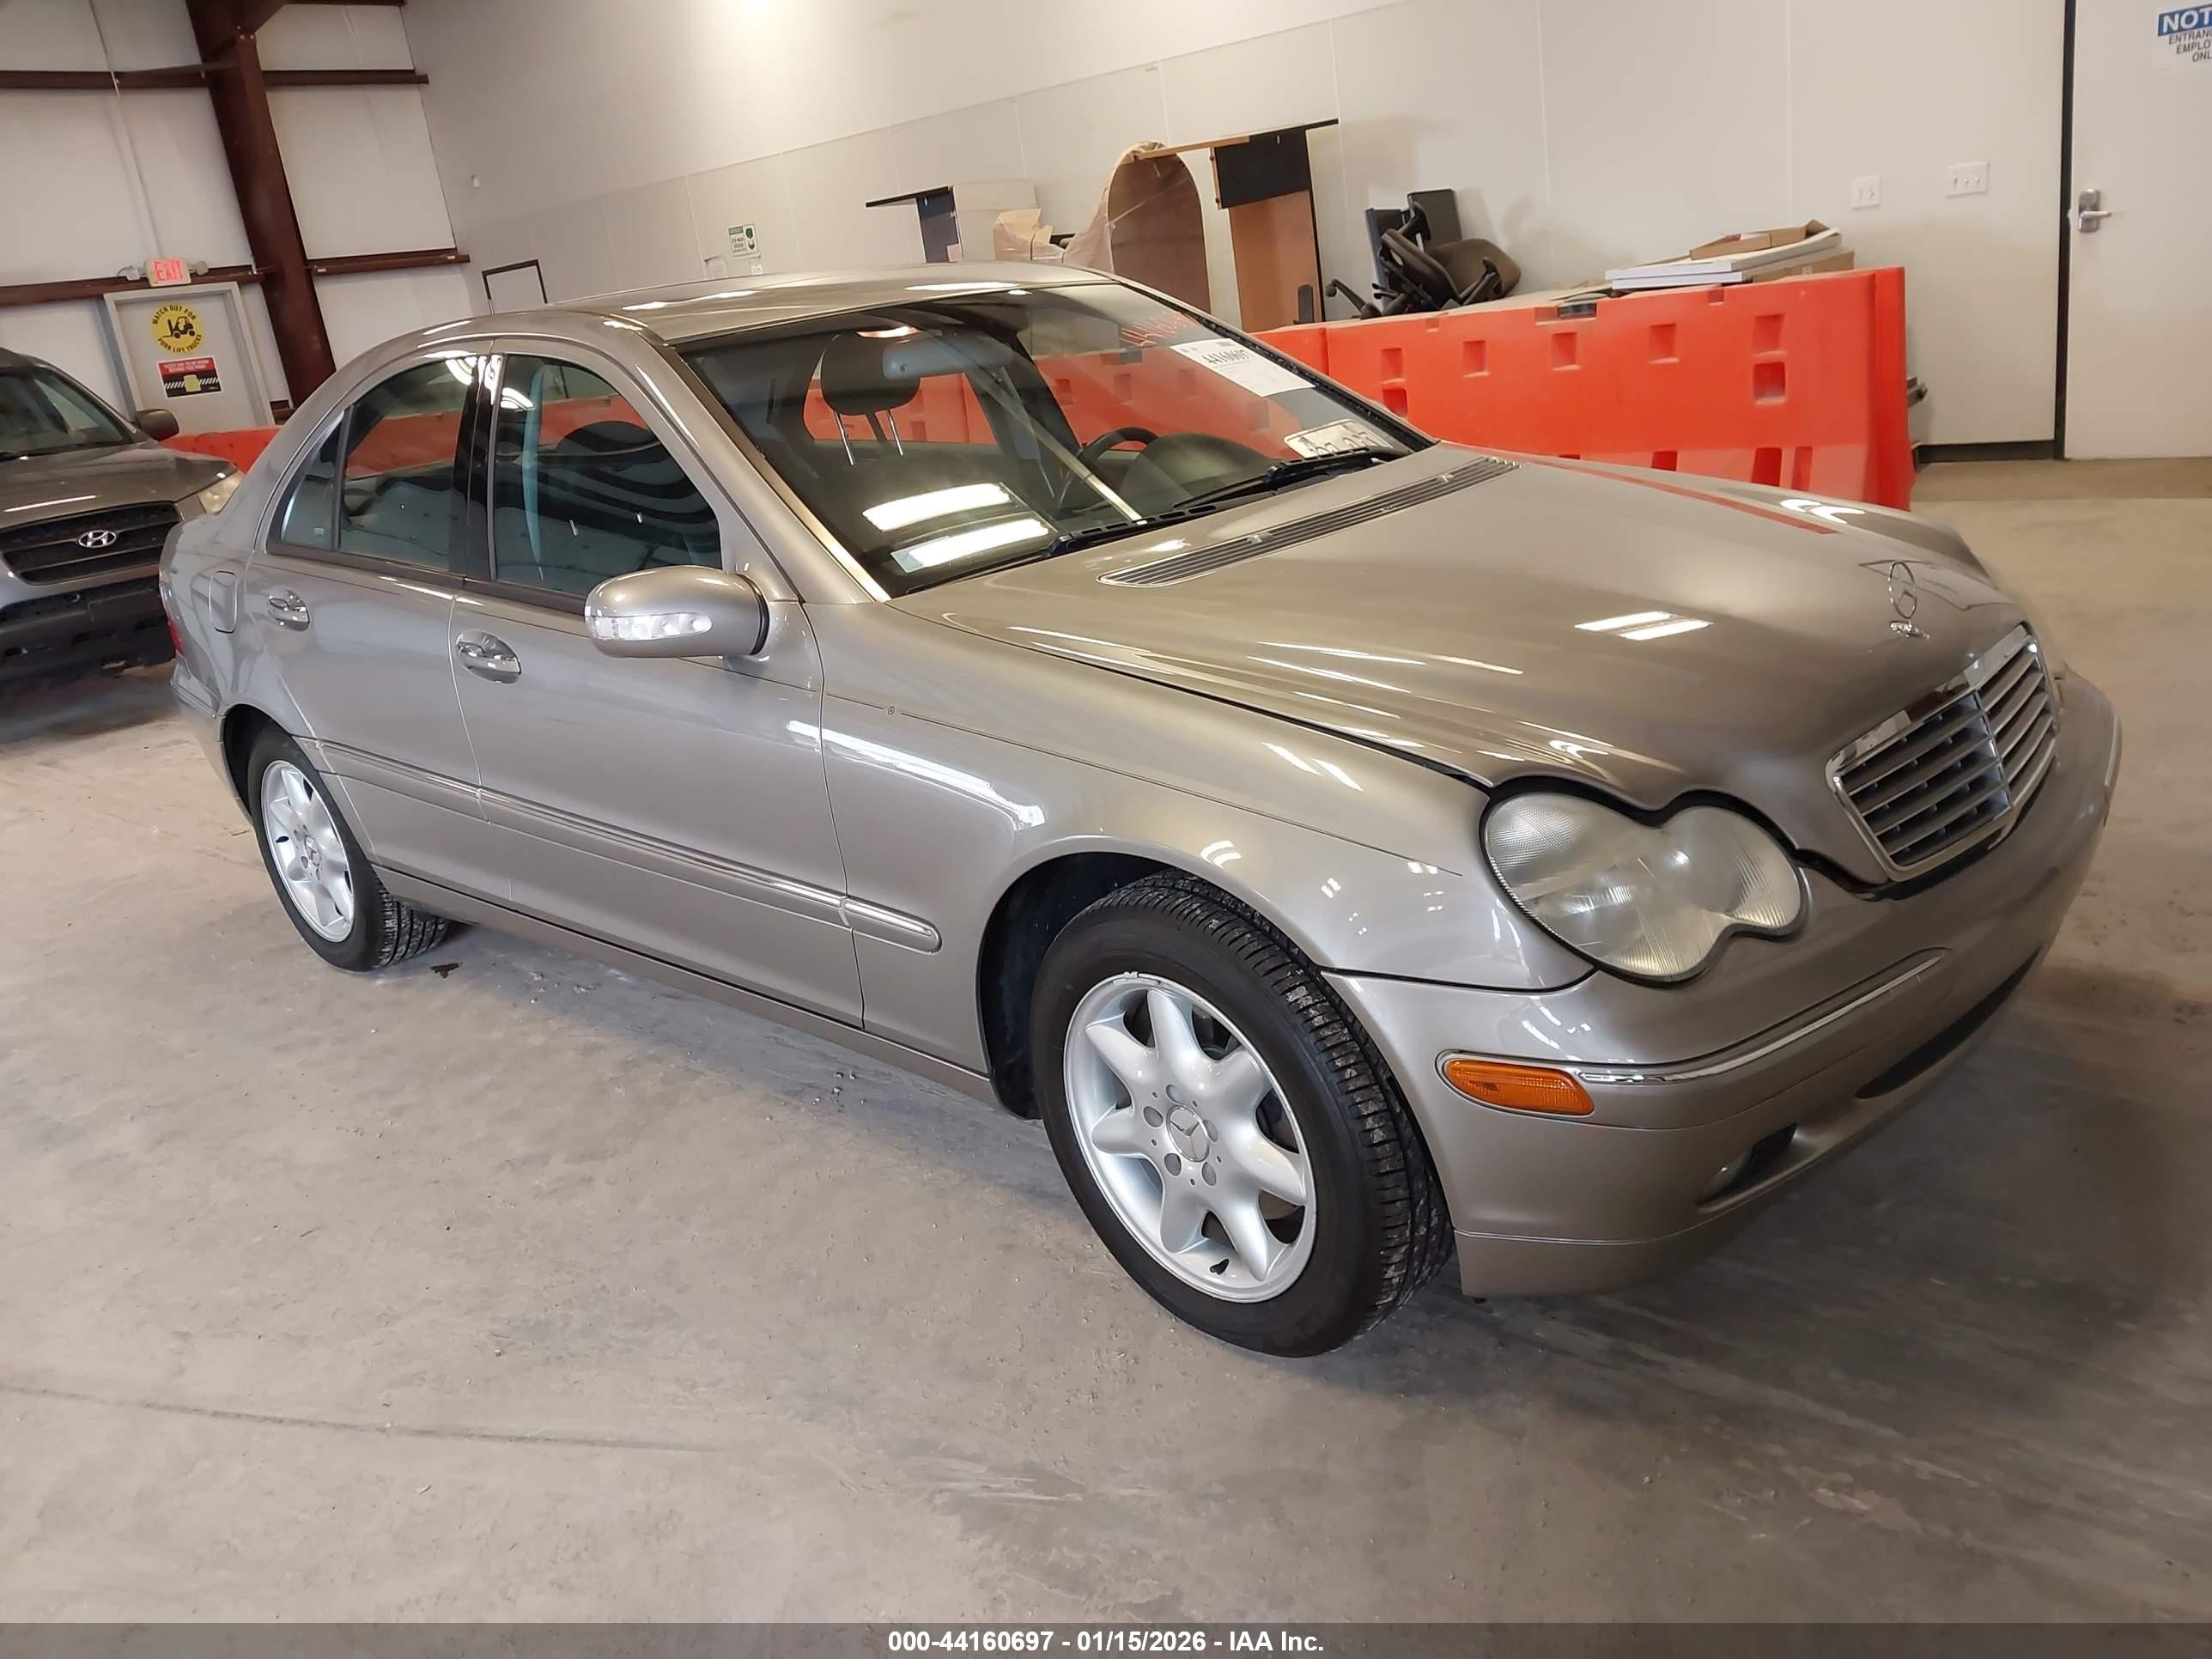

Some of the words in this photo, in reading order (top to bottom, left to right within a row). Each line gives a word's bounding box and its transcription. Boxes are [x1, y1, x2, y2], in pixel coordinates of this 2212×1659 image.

[152, 307, 168, 324] WATCH
[184, 308, 197, 320] FOR
[157, 337, 172, 350] FORK
[185, 334, 202, 352] TRUCKS
